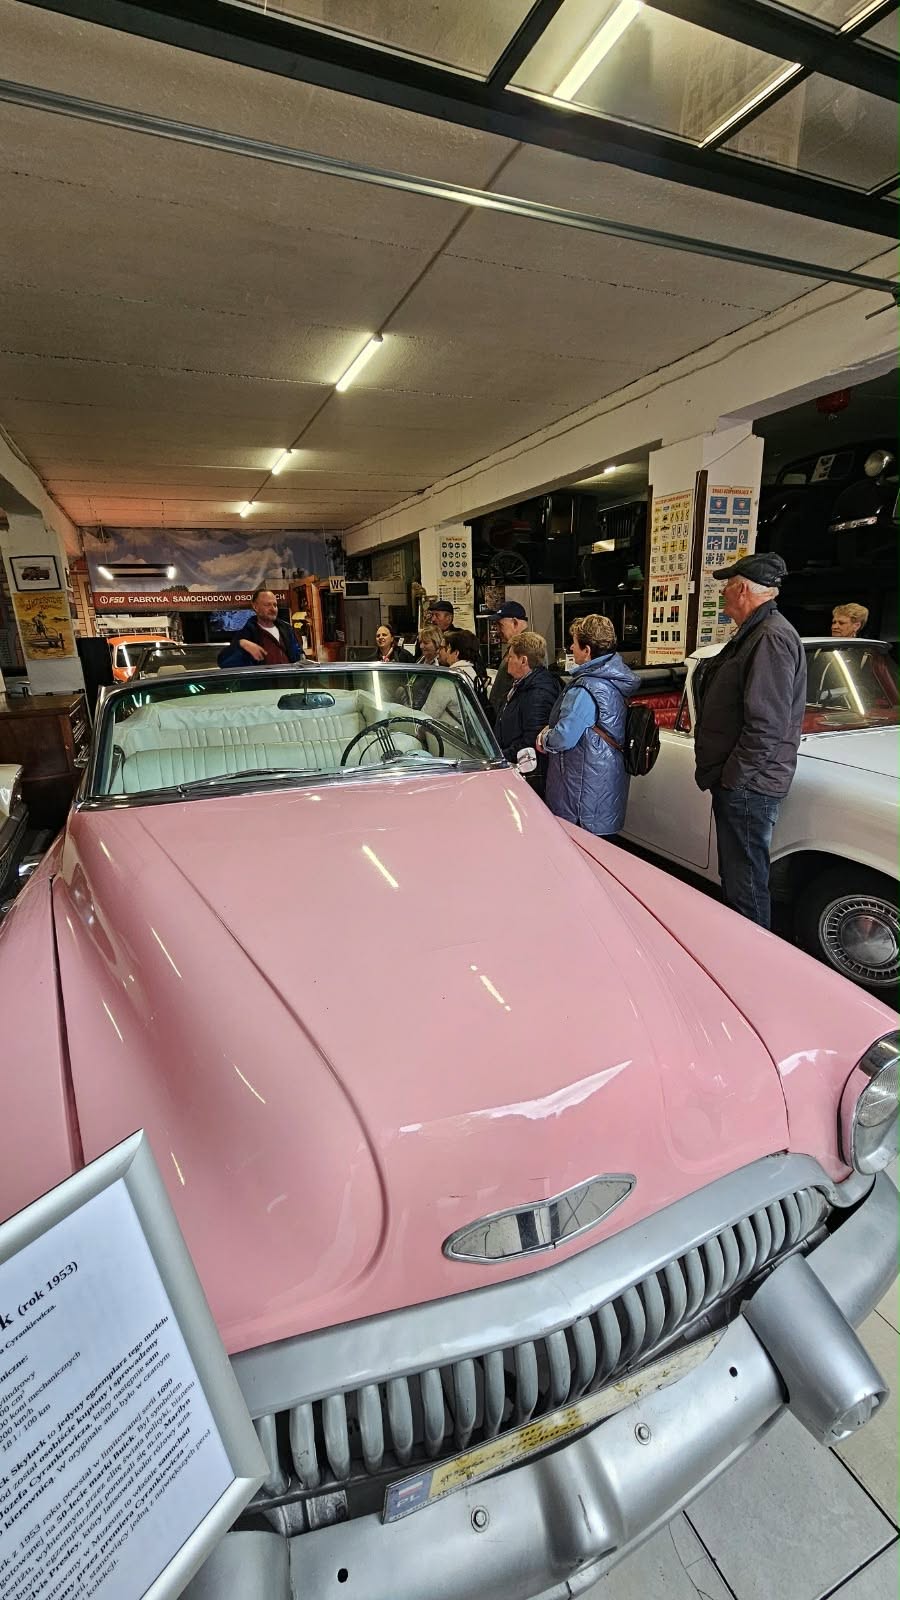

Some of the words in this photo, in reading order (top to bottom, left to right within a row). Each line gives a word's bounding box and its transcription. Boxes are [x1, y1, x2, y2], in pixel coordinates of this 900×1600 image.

[172, 594, 232, 603] SAMOCHODÓW
[234, 593, 286, 601] OSOCH
[330, 579, 345, 590] WC
[5, 1305, 56, 1348] Cyrankiewicza.
[18, 1290, 44, 1316] (rok
[47, 1261, 77, 1291] 1953)
[2, 1441, 12, 1451] 18
[24, 1415, 37, 1431] 100
[38, 1404, 50, 1417] km
[4, 1469, 55, 1529] kierownicą.
[56, 1460, 65, 1472] W
[68, 1425, 102, 1462] oryginale
[104, 1407, 118, 1424] auto
[119, 1390, 135, 1407] było
[143, 1353, 170, 1382] czarnym
[9, 1401, 26, 1420] koni
[28, 1351, 80, 1403] mechanicznych
[11, 1440, 46, 1476] Skylark
[47, 1430, 56, 1439] to
[57, 1400, 83, 1431] jedyny
[86, 1358, 127, 1400] egzemplarz
[128, 1341, 142, 1357] tego
[144, 1316, 168, 1342] modelu
[13, 1461, 37, 1490] został
[39, 1424, 75, 1462] osobiście
[76, 1390, 107, 1425] kupiony
[113, 1339, 157, 1387] sprowadzony
[13, 1408, 33, 1428] km/h
[29, 1424, 92, 1487] Cyrankiewicza,
[92, 1400, 111, 1421] który
[113, 1366, 144, 1400] następnie
[145, 1351, 159, 1367] sam
[20, 1524, 40, 1548] 1953
[42, 1503, 61, 1525] roku
[62, 1467, 92, 1503] powstał
[92, 1459, 99, 1467] w
[101, 1413, 141, 1459] limitowanej
[142, 1396, 156, 1414] serii
[157, 1378, 172, 1397] 1690
[35, 1507, 84, 1562] wybieranym
[85, 1483, 105, 1508] przez
[106, 1464, 122, 1482] elitę
[123, 1438, 144, 1464] świata
[144, 1408, 171, 1439] polityki,
[171, 1381, 194, 1408] biznesu
[45, 1524, 56, 1536] na
[57, 1488, 87, 1524] 50-lecie
[89, 1459, 112, 1488] marki
[113, 1436, 136, 1460] Buick.
[137, 1417, 149, 1432] Był
[150, 1382, 182, 1418] symbolem
[45, 1499, 103, 1567] egzemplarzami
[104, 1461, 135, 1501] poruszali
[136, 1450, 146, 1462] się
[147, 1431, 163, 1449] m.in.
[164, 1399, 190, 1429] Marilyn
[49, 1542, 81, 1578] Presley,
[82, 1514, 101, 1539] który
[103, 1476, 134, 1514] lansował
[134, 1455, 151, 1477] kolor
[153, 1427, 175, 1456] różowy
[177, 1411, 192, 1428] auta.
[77, 1553, 97, 1582] przez
[100, 1510, 134, 1554] premiera
[135, 1449, 184, 1509] Cyrankiewicza
[89, 1530, 128, 1580] stanowiący
[130, 1506, 149, 1531] jedną
[154, 1449, 195, 1500] największych
[91, 1509, 123, 1547] Muzeum
[124, 1499, 131, 1508] to
[132, 1467, 157, 1497] właśnie
[158, 1427, 190, 1467] samochód
[396, 1494, 421, 1508] PL
[86, 1560, 118, 1598] kolekcji.
